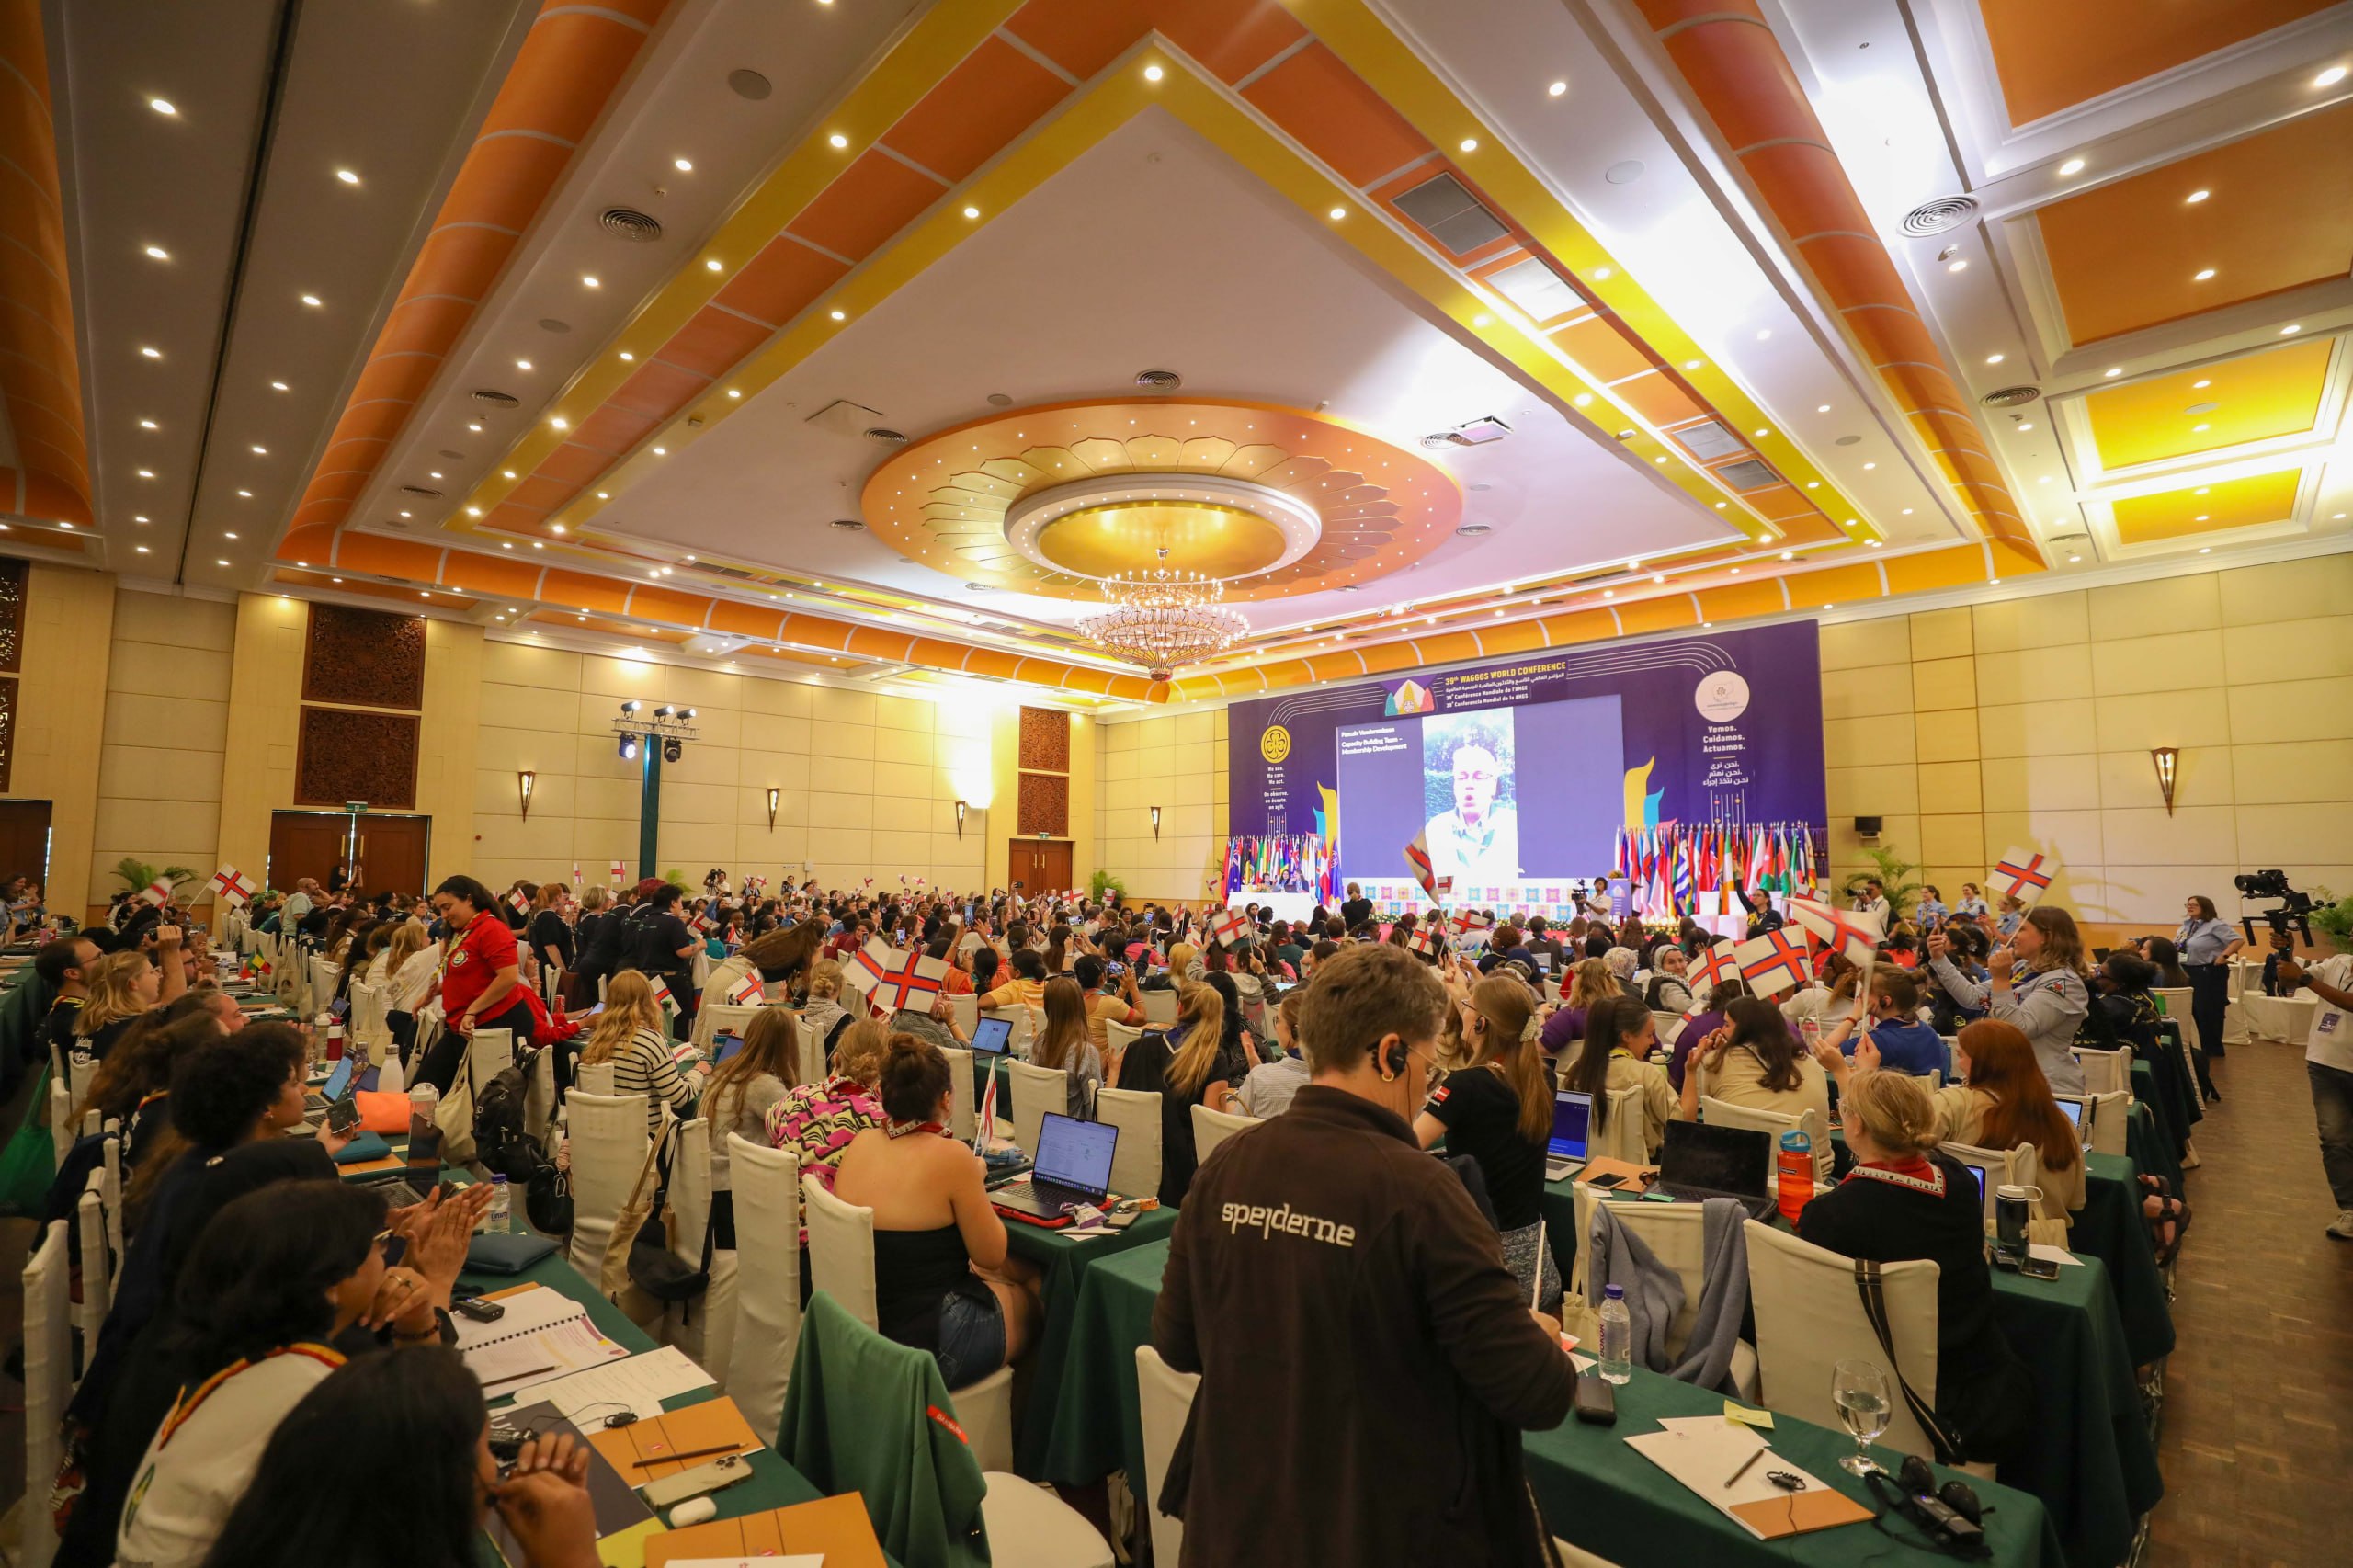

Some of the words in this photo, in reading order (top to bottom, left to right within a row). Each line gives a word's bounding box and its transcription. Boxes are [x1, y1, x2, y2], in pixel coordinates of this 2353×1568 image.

[1460, 672, 1489, 684] WAGGGS
[1490, 668, 1516, 679] WORLD
[1518, 662, 1566, 676] CONFERENCE
[1707, 725, 1737, 733] Vemos.
[1702, 734, 1745, 744] Cuidamos.
[1702, 744, 1745, 753] Actuamos.
